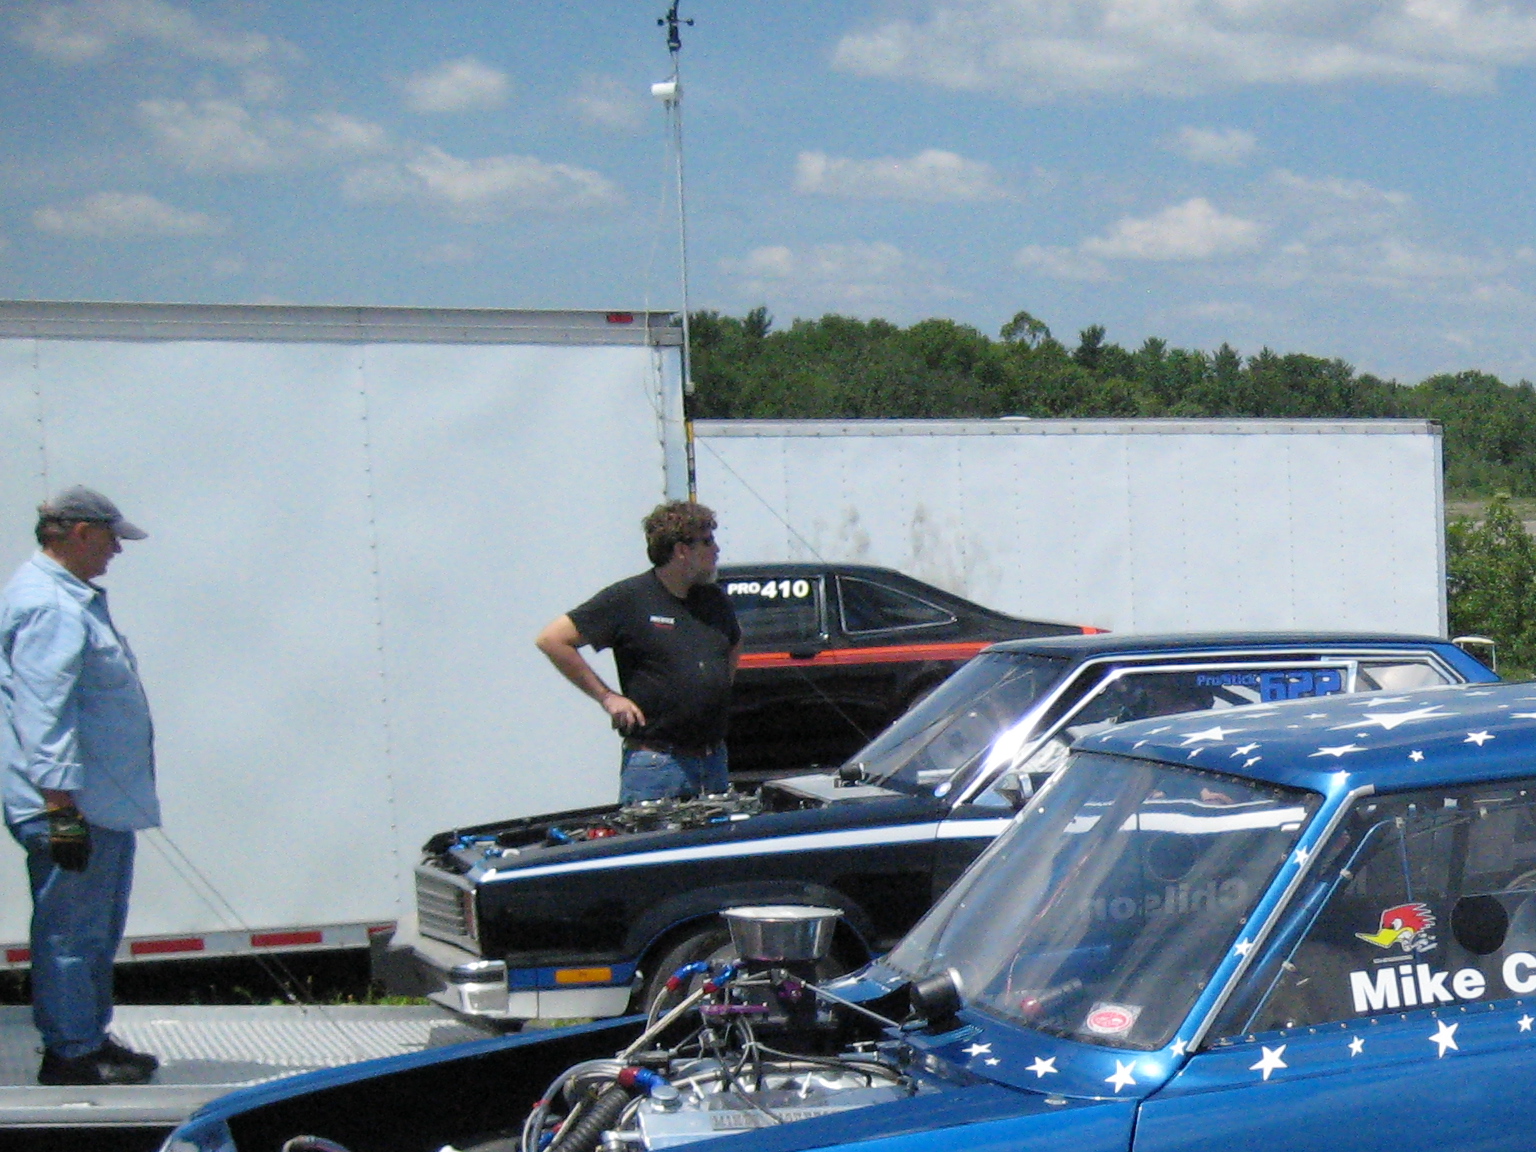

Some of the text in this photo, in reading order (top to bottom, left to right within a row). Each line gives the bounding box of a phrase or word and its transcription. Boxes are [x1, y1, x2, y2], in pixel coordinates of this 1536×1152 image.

[727, 580, 809, 599] PRO 410
[1350, 963, 1486, 1012] Mike
